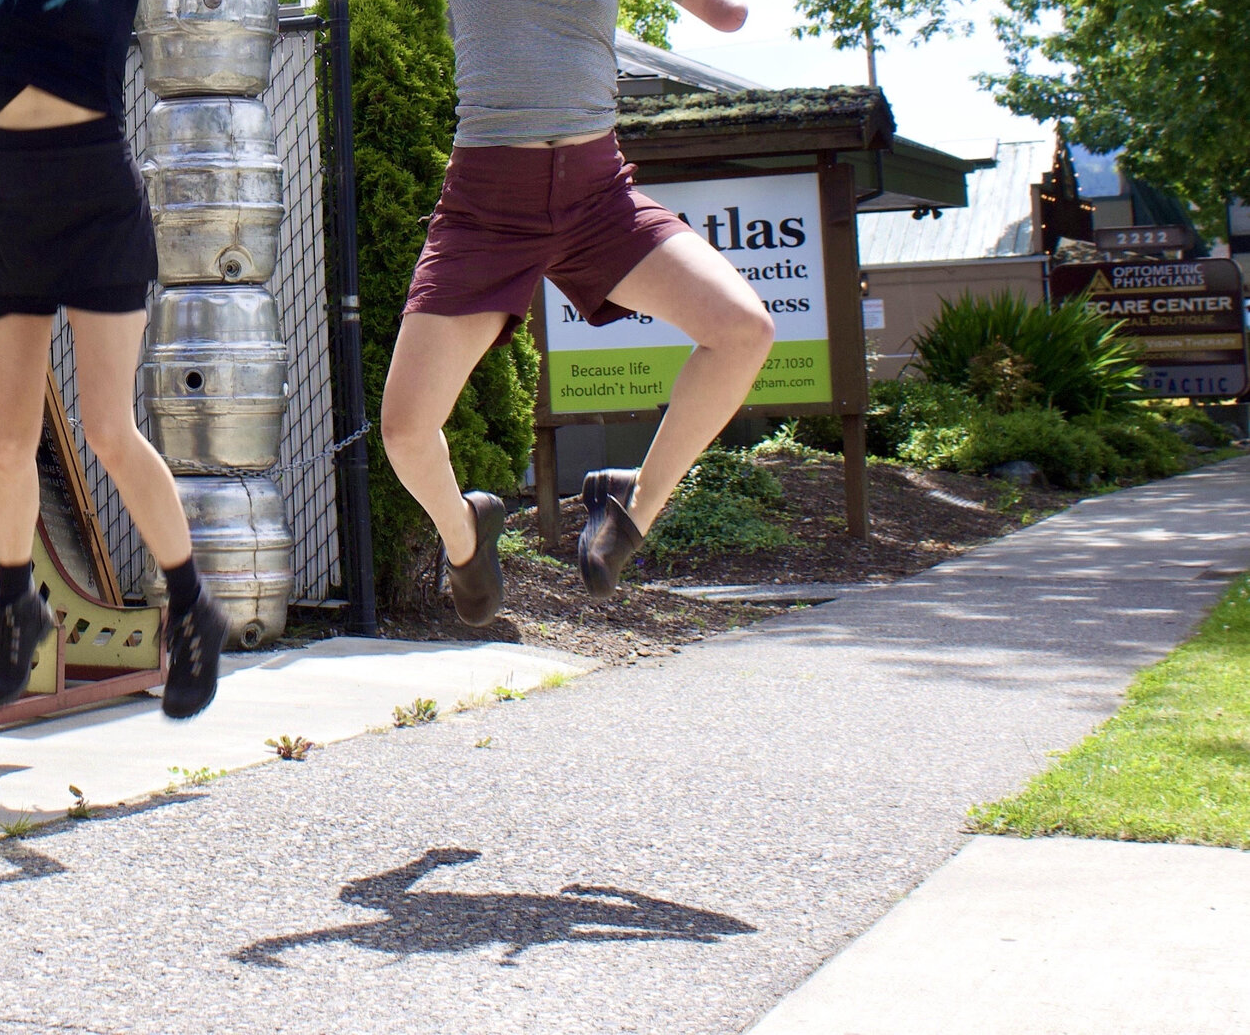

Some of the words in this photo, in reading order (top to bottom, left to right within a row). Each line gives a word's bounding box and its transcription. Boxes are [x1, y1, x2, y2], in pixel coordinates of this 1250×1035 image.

[677, 206, 807, 252] tlas
[1116, 231, 1168, 245] 2222
[1112, 264, 1204, 278] OPTOMETRIC
[1113, 275, 1205, 288] PHYSICIANS
[1152, 296, 1233, 313] CENTER
[570, 363, 625, 378] Because
[629, 361, 651, 376] life
[560, 381, 625, 398] shouldn't
[629, 380, 664, 395] hurt!
